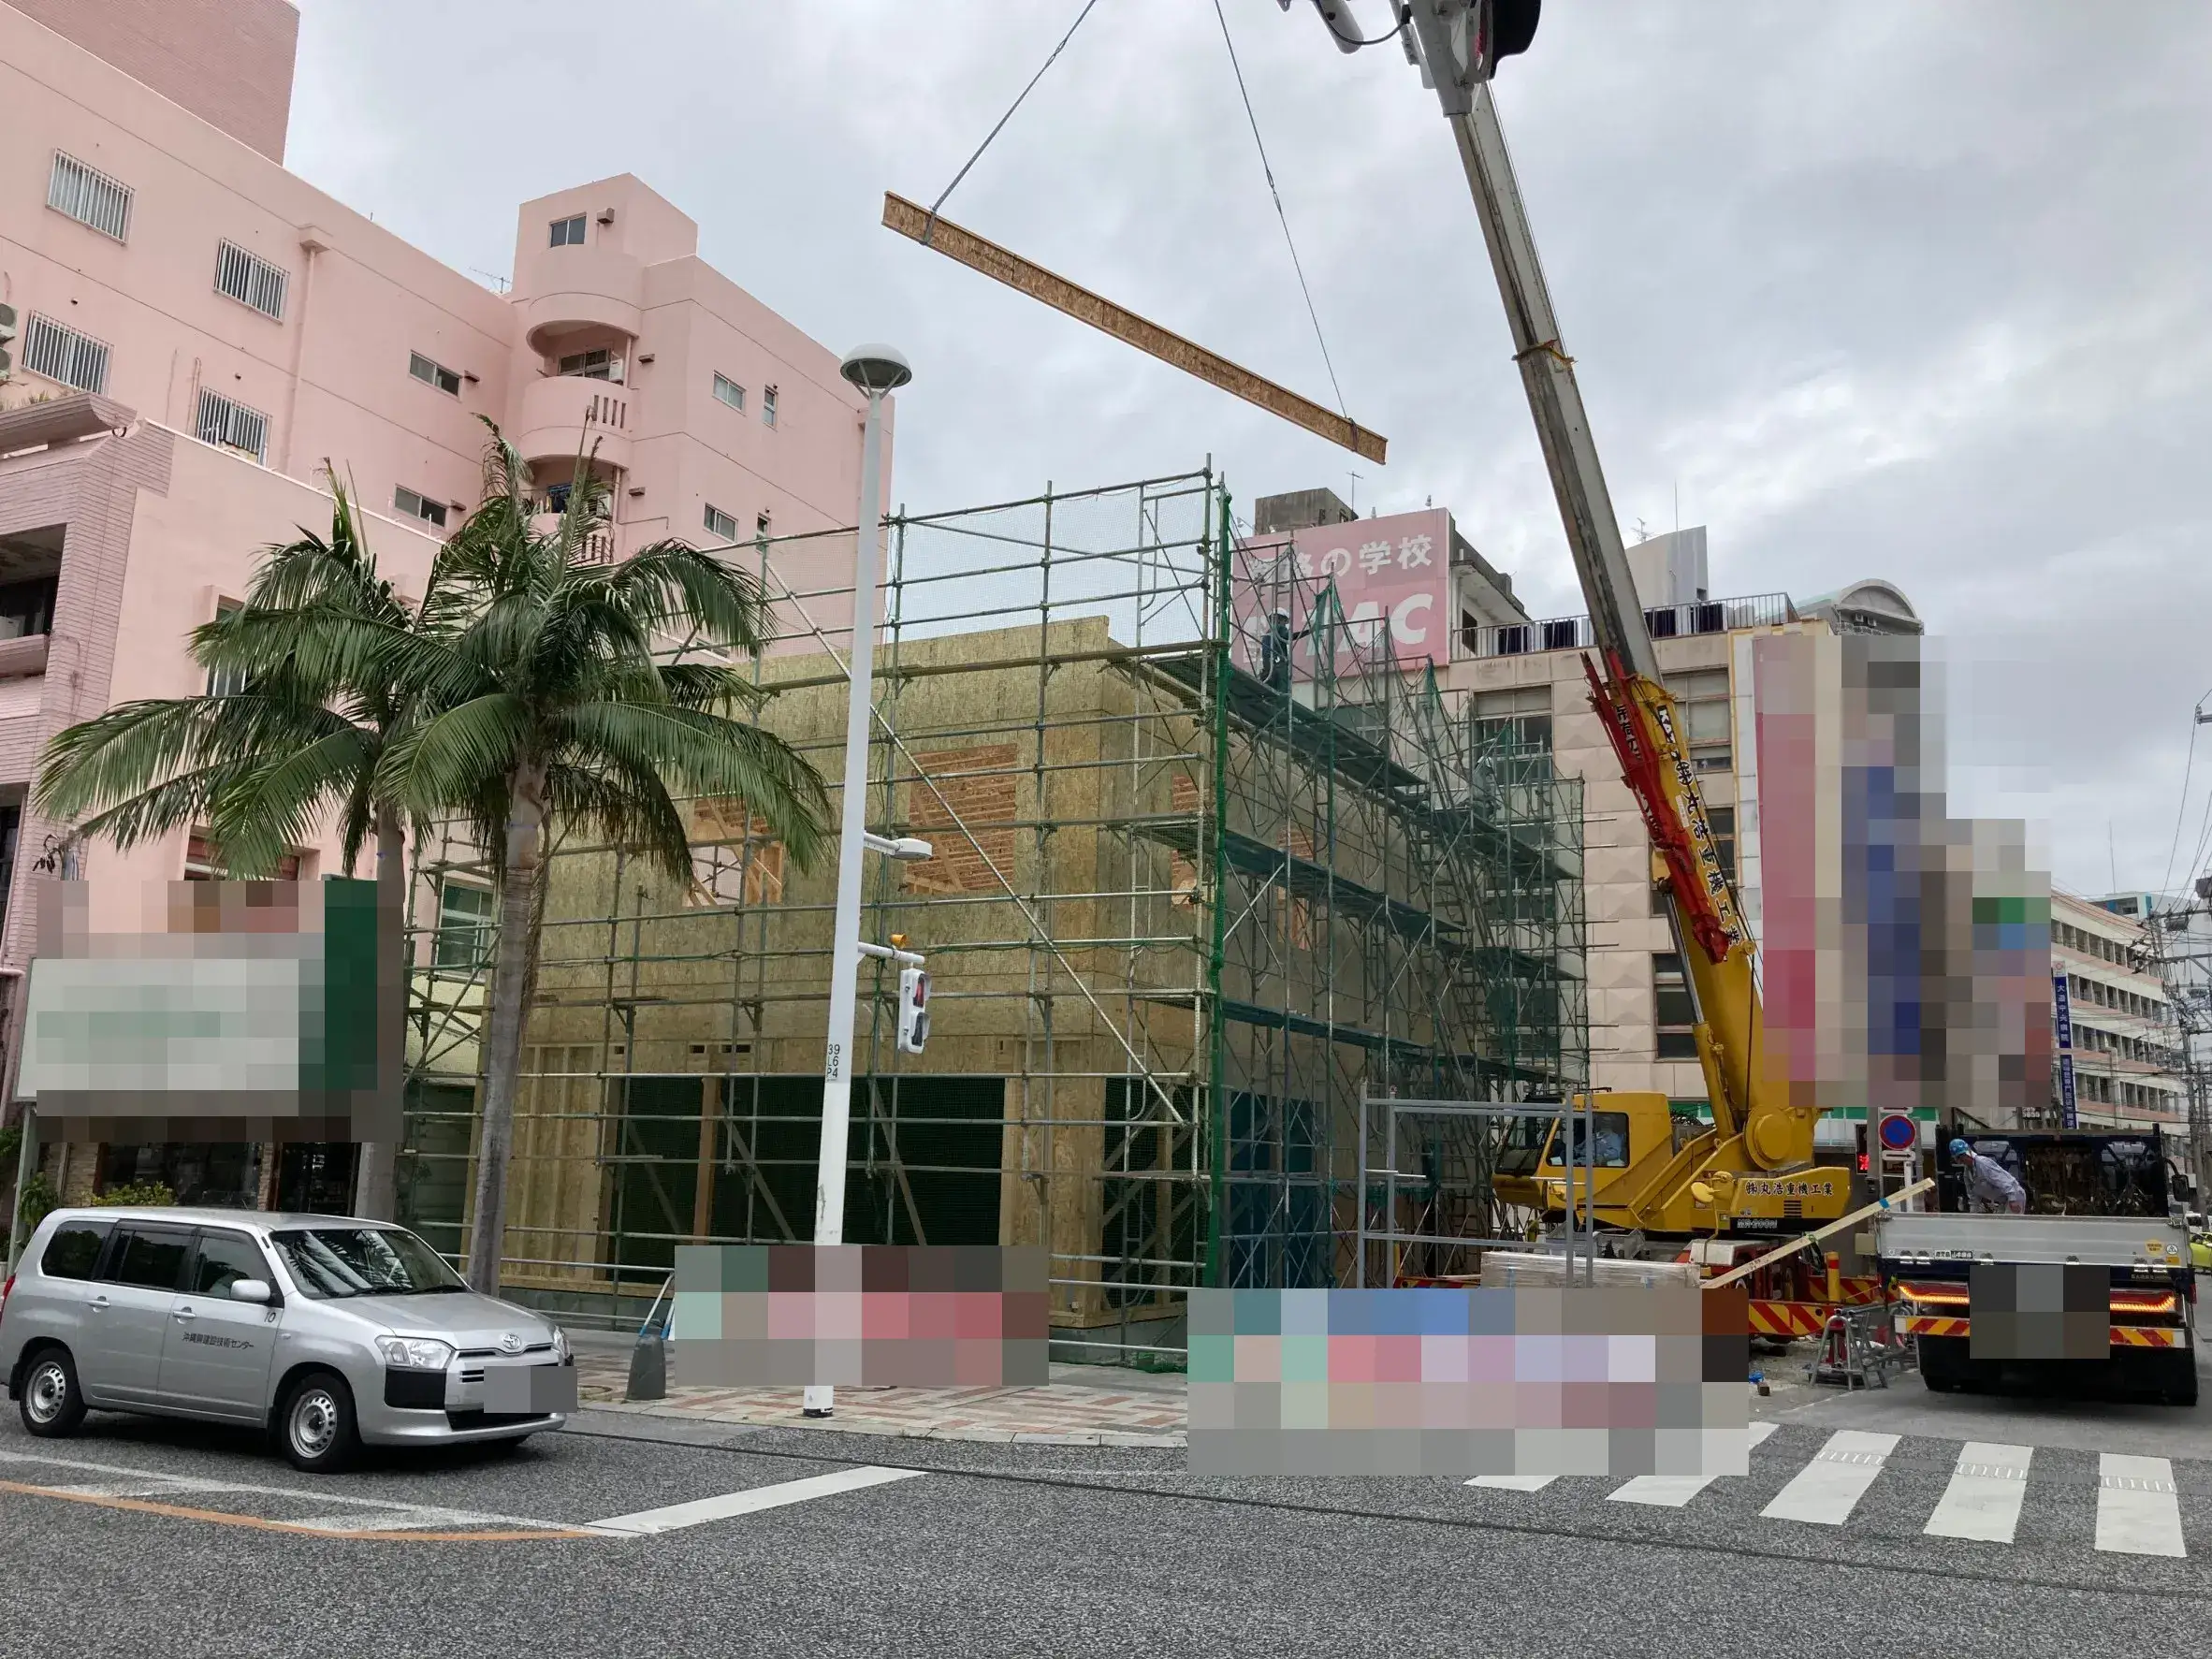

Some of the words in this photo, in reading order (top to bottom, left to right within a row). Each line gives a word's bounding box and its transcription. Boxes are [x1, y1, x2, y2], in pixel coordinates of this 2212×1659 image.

[828, 1043, 840, 1055] 39
[826, 1067, 838, 1078] P4
[264, 1312, 276, 1323] 10
